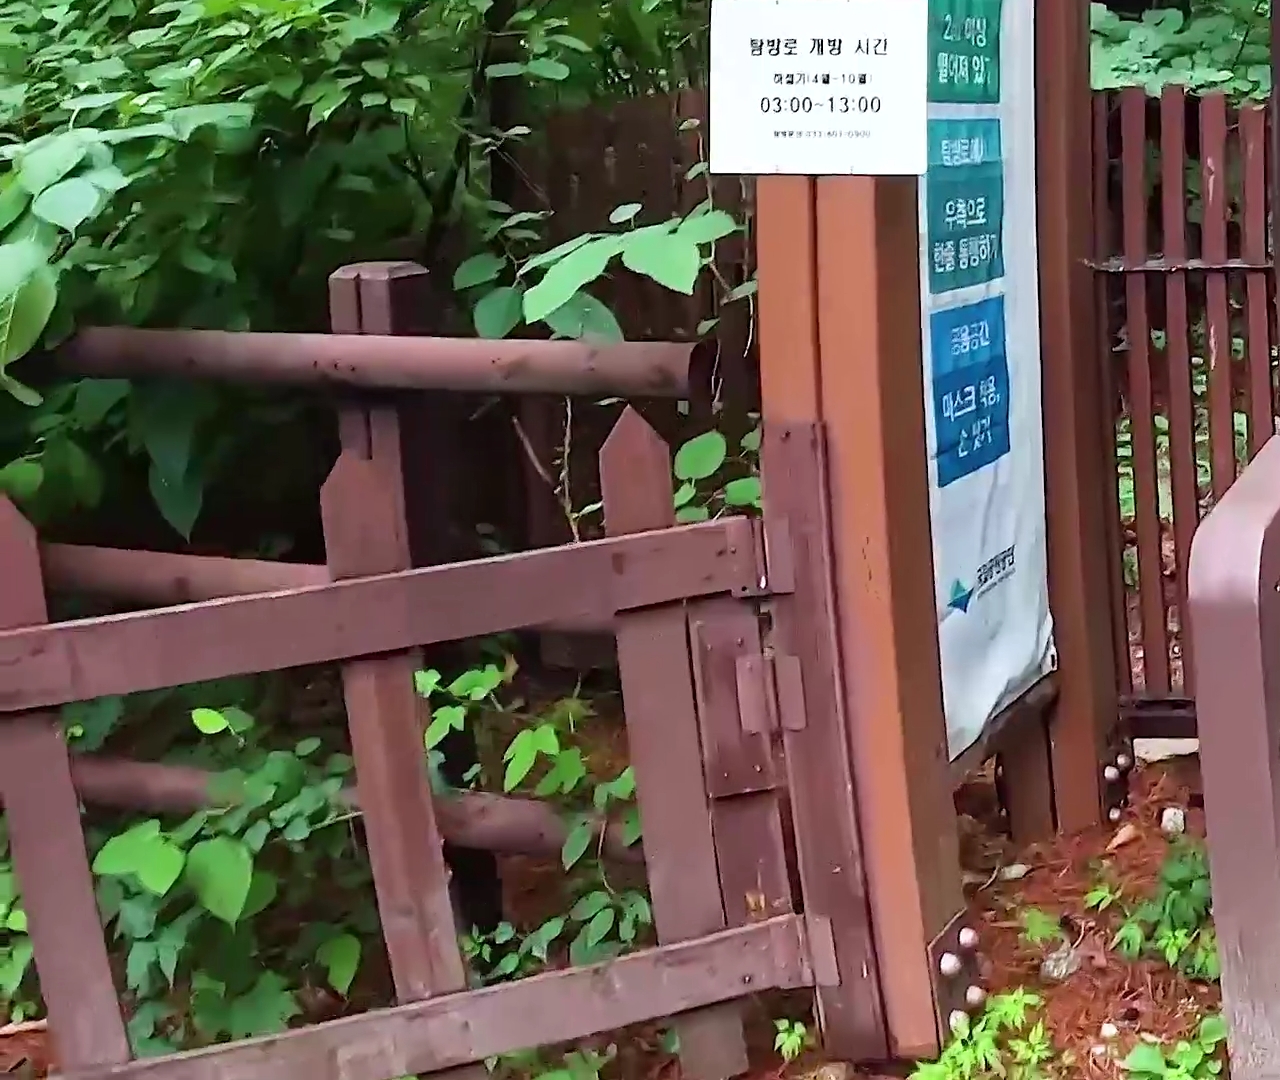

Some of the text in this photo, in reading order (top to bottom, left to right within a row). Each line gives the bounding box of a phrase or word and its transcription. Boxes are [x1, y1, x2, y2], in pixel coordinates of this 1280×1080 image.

[750, 37, 888, 56] 탐방로 개방 시간
[944, 197, 987, 230] 우측으로
[942, 384, 977, 422] 마스크
